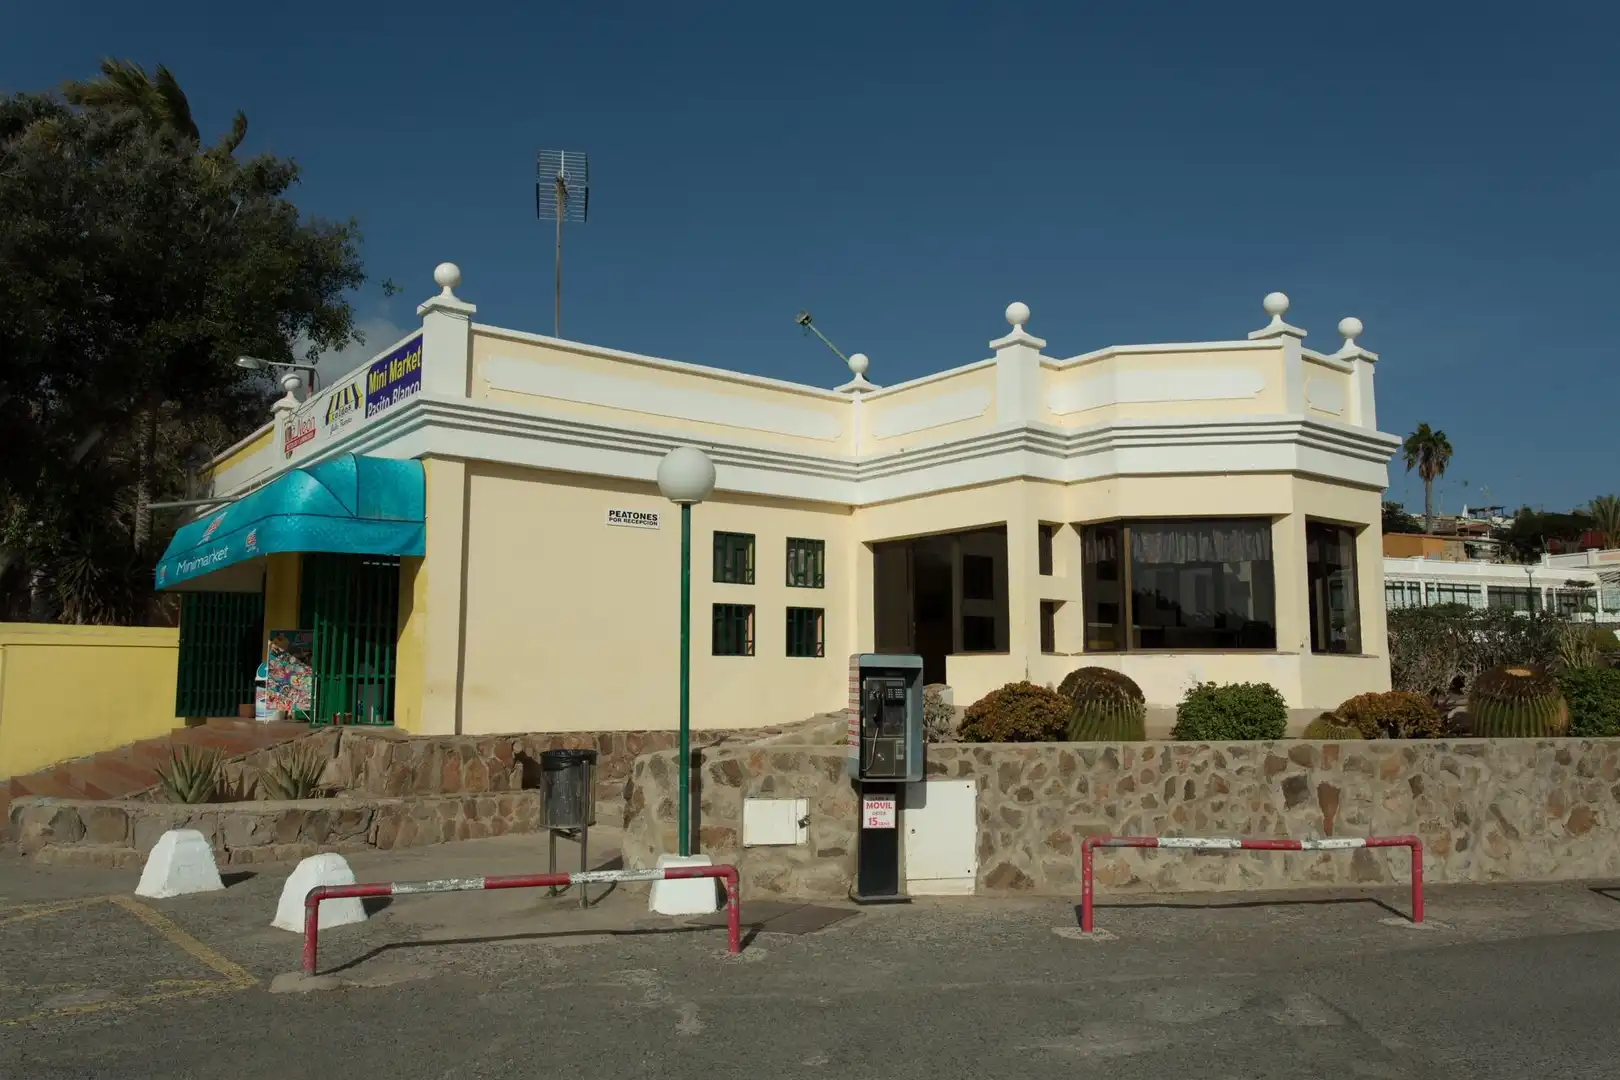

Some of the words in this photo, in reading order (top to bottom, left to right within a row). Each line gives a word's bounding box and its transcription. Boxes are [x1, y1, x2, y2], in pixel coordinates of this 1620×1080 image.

[368, 364, 387, 395] Mini
[389, 345, 421, 383] Market
[367, 395, 390, 417] Pasito
[392, 381, 420, 404] Blanco
[609, 510, 658, 521] PEATONES
[175, 544, 229, 576] Minimarket
[868, 817, 878, 826] 15
